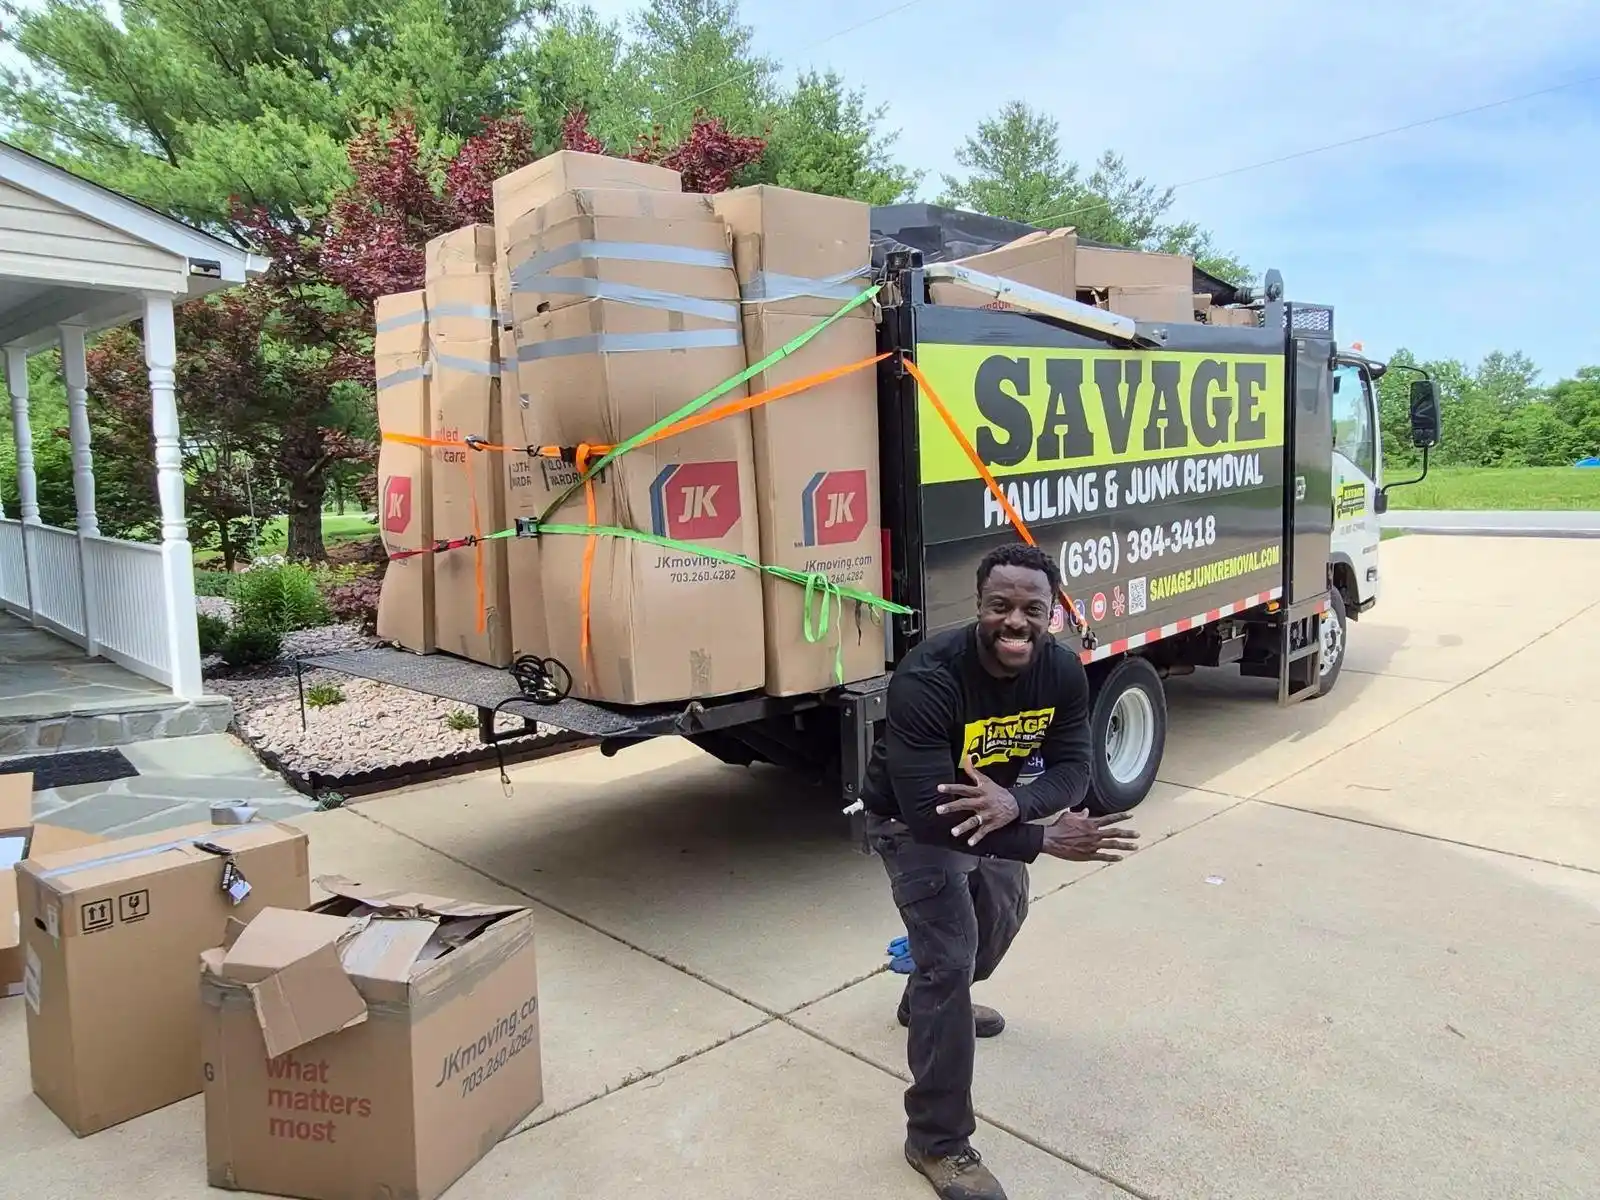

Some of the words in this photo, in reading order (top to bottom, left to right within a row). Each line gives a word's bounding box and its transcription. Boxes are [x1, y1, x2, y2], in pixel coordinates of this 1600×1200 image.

[974, 354, 1266, 468] SAVAGE
[444, 450, 466, 463] care
[678, 484, 722, 523] JK
[983, 472, 1099, 529] HAULING
[1104, 470, 1119, 509] &
[1124, 460, 1180, 505] JUNK
[1184, 453, 1264, 494] REMOVAL
[824, 492, 856, 528] JK
[802, 555, 872, 572] JKmoving.com
[1059, 531, 1120, 586] (636)
[1126, 515, 1216, 564] 384-3418
[670, 569, 736, 584] 703.260.4282
[1149, 545, 1280, 601] SAVAGEJUNKREMOVAL.COM
[987, 716, 1049, 742] SAVAGE
[436, 996, 538, 1087] JKmoving.co
[265, 1054, 329, 1083] what
[462, 1024, 533, 1098] 703.260.4282
[268, 1088, 372, 1118] matters
[269, 1117, 337, 1143] most
